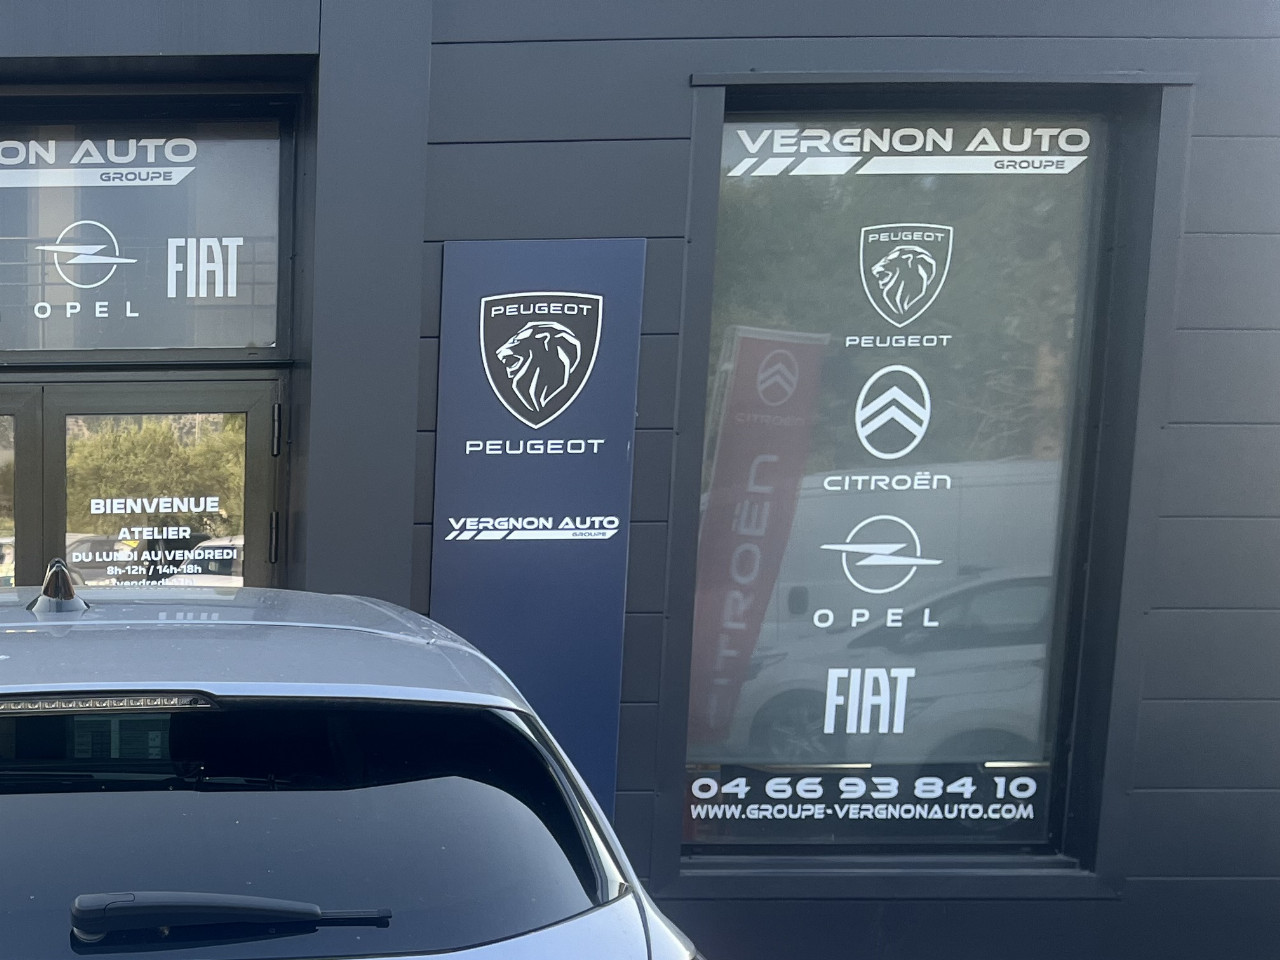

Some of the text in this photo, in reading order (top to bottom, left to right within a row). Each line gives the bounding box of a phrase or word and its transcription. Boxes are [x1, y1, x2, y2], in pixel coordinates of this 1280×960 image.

[737, 127, 1090, 153] VERGNON AUTO
[69, 138, 198, 165] AUTO
[994, 160, 1065, 170] GROUPE
[100, 171, 173, 182] GROUPE
[868, 232, 945, 243] PEUGEOT
[167, 237, 243, 297] FIAT
[34, 301, 139, 318] OPEL
[491, 303, 592, 318] PEUGEOT
[845, 335, 953, 347] PEUGEOT
[466, 439, 605, 454] PEUGEOT
[90, 497, 220, 514] BIENVENUE
[448, 516, 620, 530] VERGNON AUTO
[118, 527, 191, 540] ATELIER
[72, 549, 237, 562] DU LUNDI AU VENDREDI
[106, 565, 147, 575] 8h-12h
[156, 564, 202, 574] 14h-18h
[814, 608, 939, 627] OPEL
[823, 667, 916, 734] FIAT
[691, 776, 1037, 799] 04 66 93 84 10
[691, 803, 1034, 820] WWW.GROUPE-VERGNONAUTO.COM
